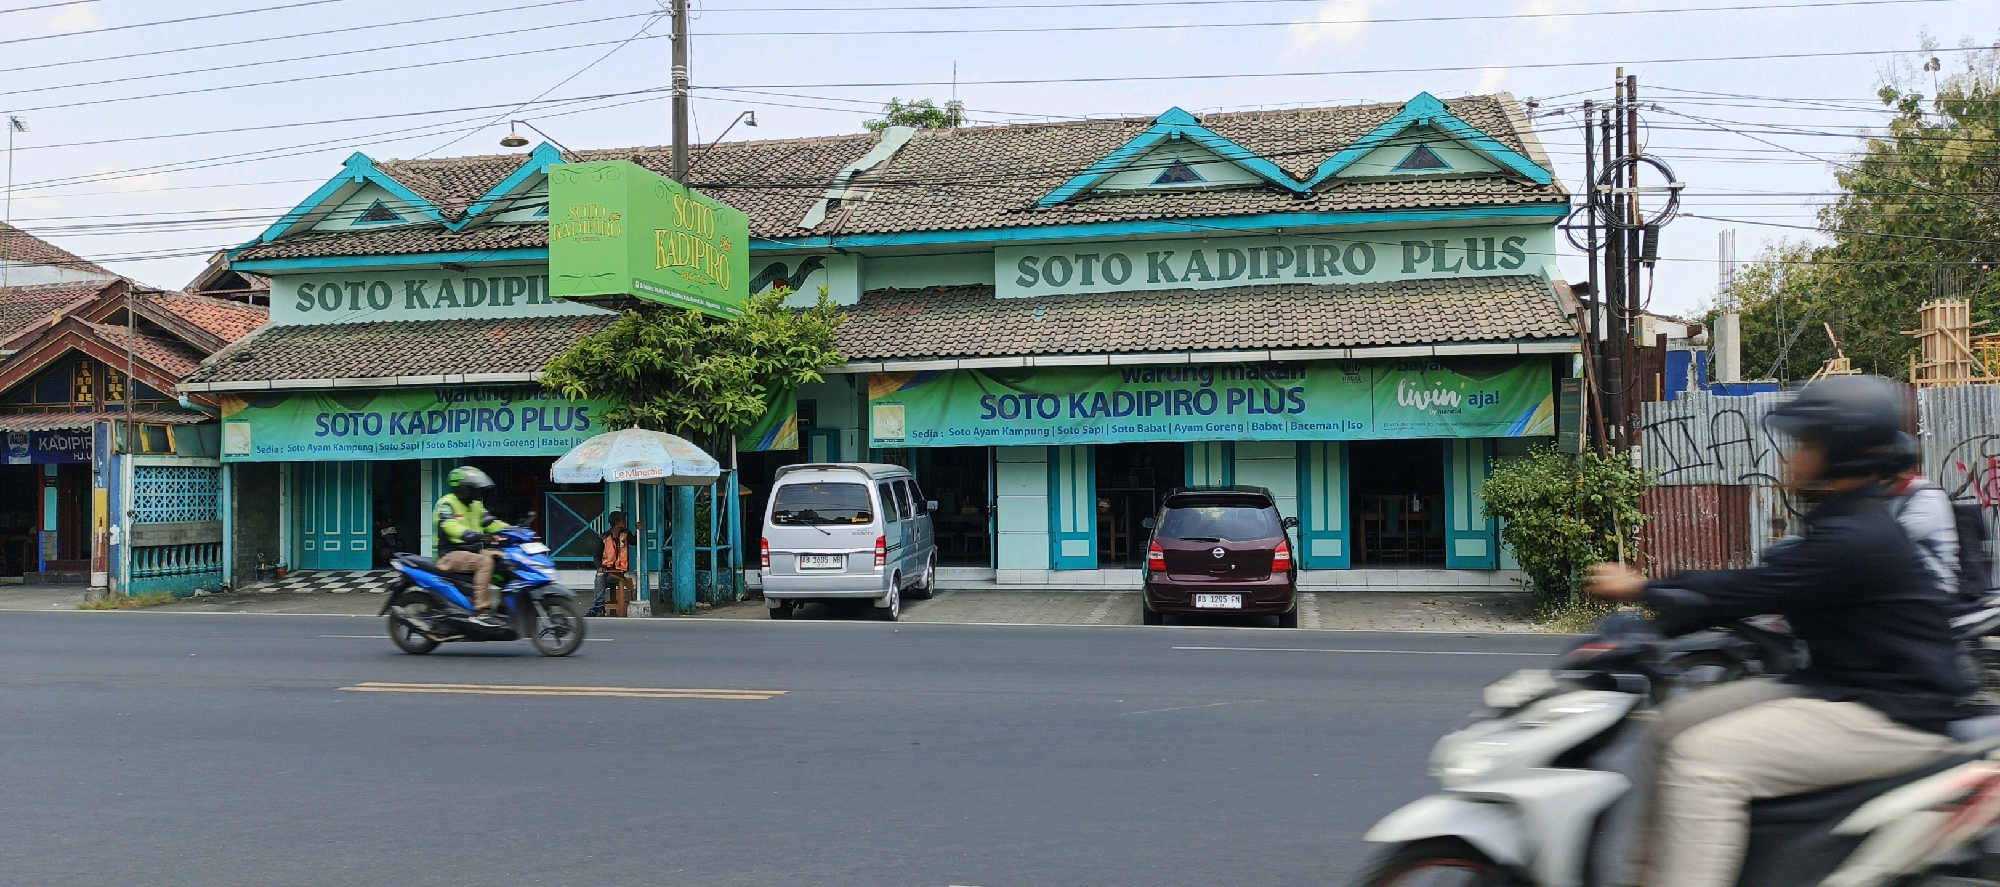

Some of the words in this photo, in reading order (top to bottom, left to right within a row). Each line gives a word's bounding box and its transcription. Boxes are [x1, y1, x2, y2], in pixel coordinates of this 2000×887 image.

[568, 203, 607, 221] SOTO
[672, 192, 715, 241] SOTO
[552, 219, 622, 242] KADIPIRO
[653, 228, 731, 292] KADIPIRO
[1016, 252, 1133, 288] SOTO
[1146, 242, 1377, 283] KADIPIRO
[1399, 235, 1529, 274] PLUS
[295, 280, 393, 312] SOTO
[1119, 362, 1214, 387] warung
[1221, 361, 1307, 381] makan
[435, 387, 513, 406] warung
[980, 392, 1061, 420] SOTO
[1069, 388, 1219, 419] KADIPIRO
[1226, 386, 1306, 415] PLUS
[1468, 390, 1500, 409] aja!
[314, 411, 383, 437] SOTO
[389, 407, 515, 437] KADIPIRO
[521, 407, 590, 431] PLUS
[949, 427, 970, 437] Soto
[973, 427, 1000, 438] Ayam
[1002, 426, 1050, 439] Kampung
[1057, 425, 1080, 435] Soto
[1082, 424, 1104, 436] Sapi
[1111, 423, 1134, 434] Soto
[1137, 422, 1166, 433] Babat
[1174, 422, 1204, 434] Ayam
[1205, 421, 1243, 434] Goreng
[1251, 420, 1283, 431] Babat
[1290, 419, 1339, 431] Baceman
[1348, 419, 1363, 430] Iso
[287, 443, 306, 452] Soto
[307, 443, 331, 454] Ayam
[333, 442, 373, 454] Kampung
[379, 442, 400, 452] Soto
[400, 441, 420, 453] Sapi
[426, 440, 445, 450] Soto
[447, 439, 471, 449] Babat
[475, 439, 501, 450] Ayam
[502, 438, 535, 451] Goreng
[541, 436, 569, 446] Babat
